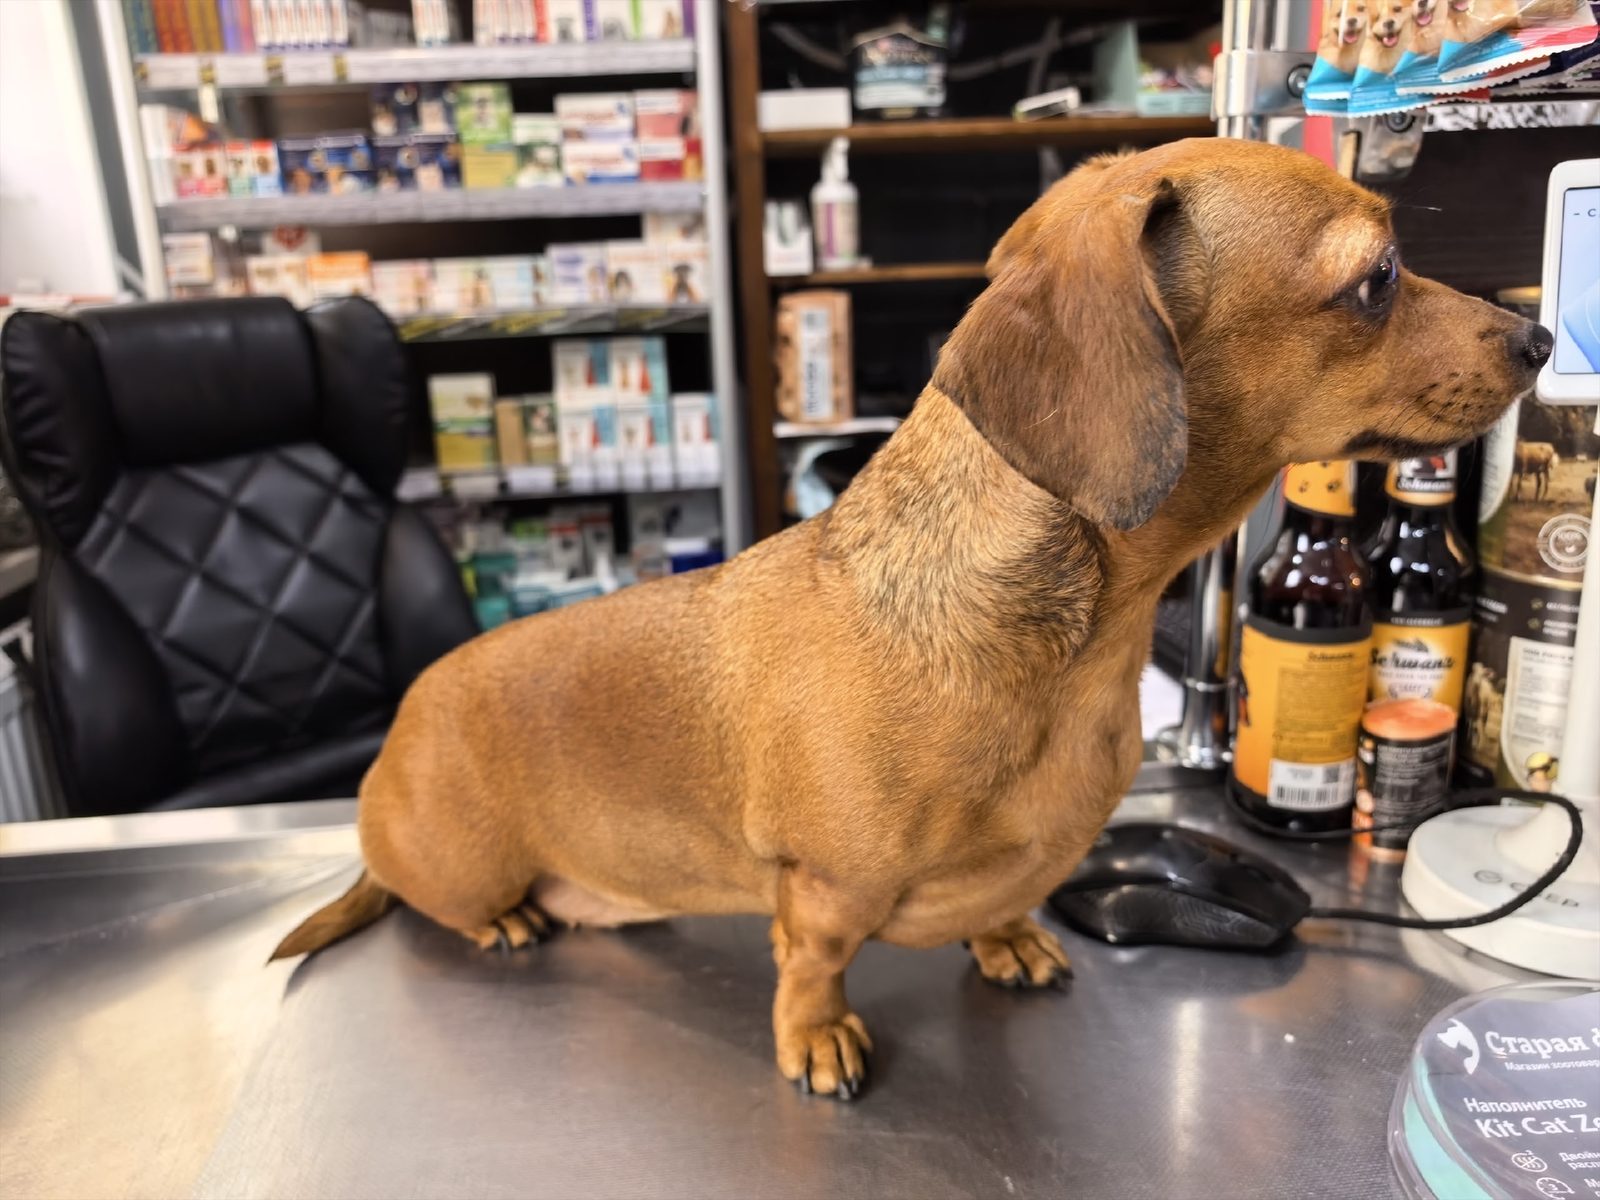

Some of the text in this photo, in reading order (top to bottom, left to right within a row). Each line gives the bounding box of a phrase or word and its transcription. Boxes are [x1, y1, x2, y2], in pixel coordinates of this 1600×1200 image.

[1484, 1030, 1591, 1059] Старая
[1463, 1097, 1588, 1113] Наполнитель
[1474, 1117, 1522, 1138] Kit
[1521, 1116, 1574, 1135] Cat
